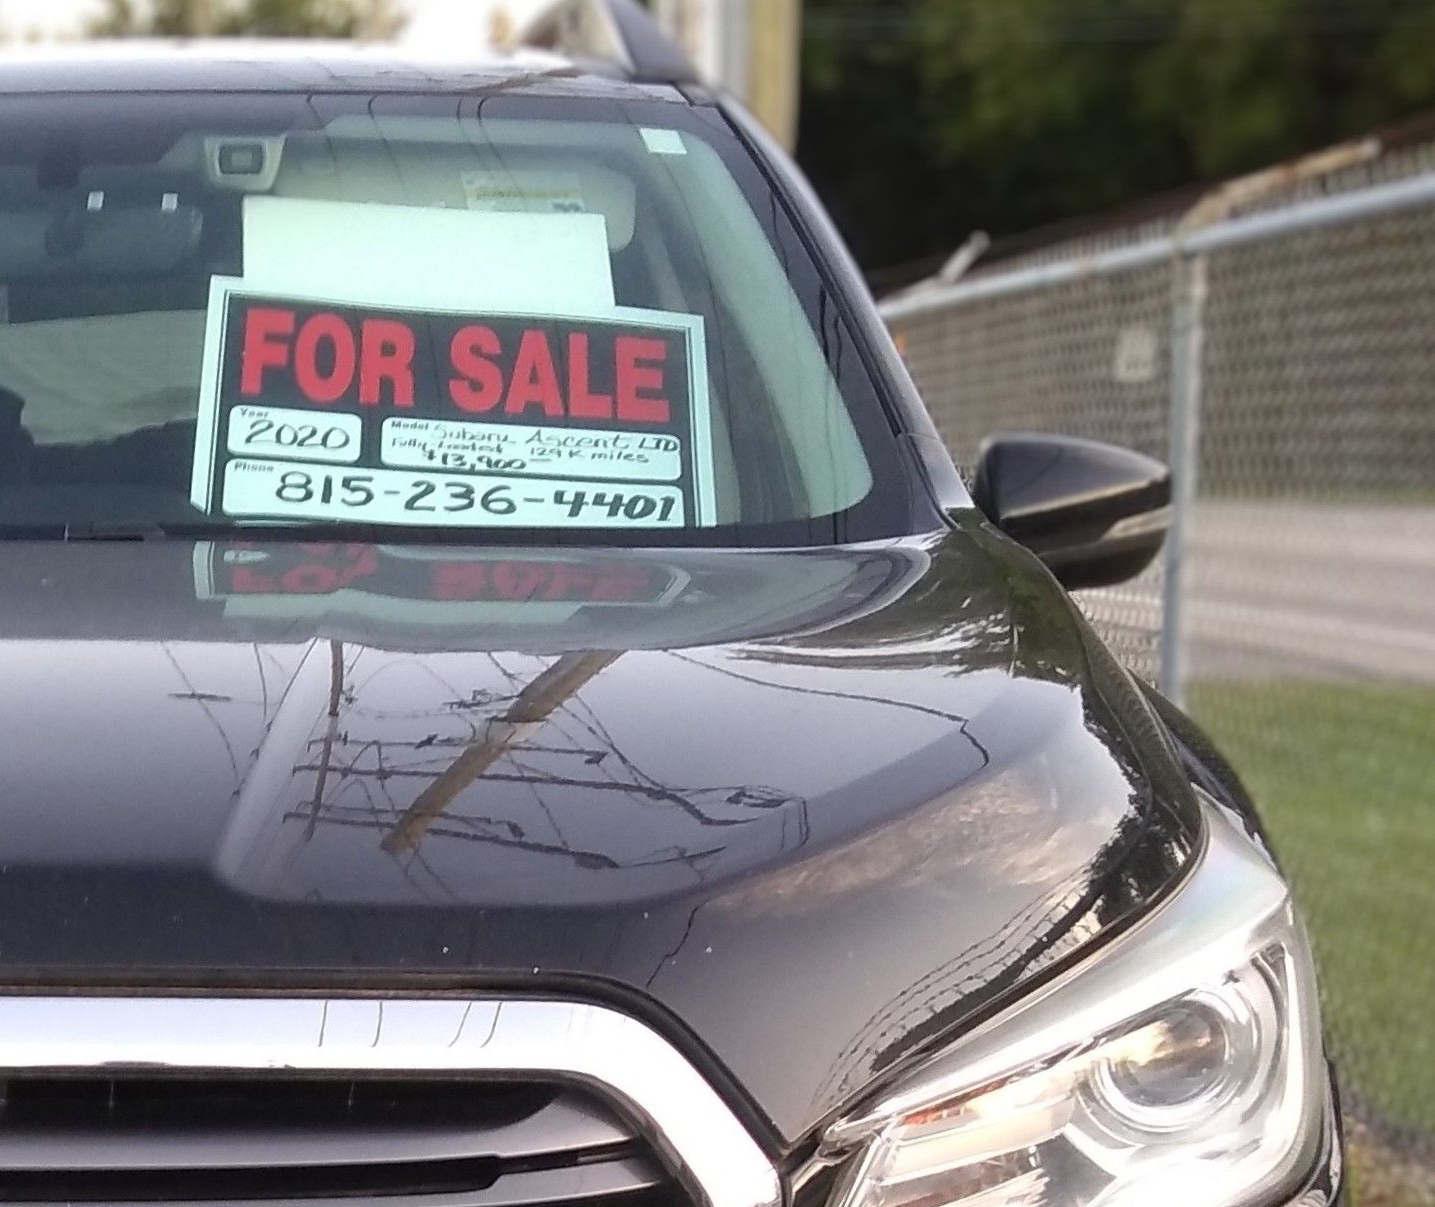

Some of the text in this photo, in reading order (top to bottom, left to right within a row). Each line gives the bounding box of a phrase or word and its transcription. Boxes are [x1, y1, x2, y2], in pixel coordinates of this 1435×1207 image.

[240, 307, 672, 423] FOR SALE
[244, 419, 351, 449] 2020
[525, 429, 631, 449] Ascent
[638, 437, 679, 451] LTD
[590, 450, 650, 464] miles
[275, 471, 675, 522] 815-236-4401
